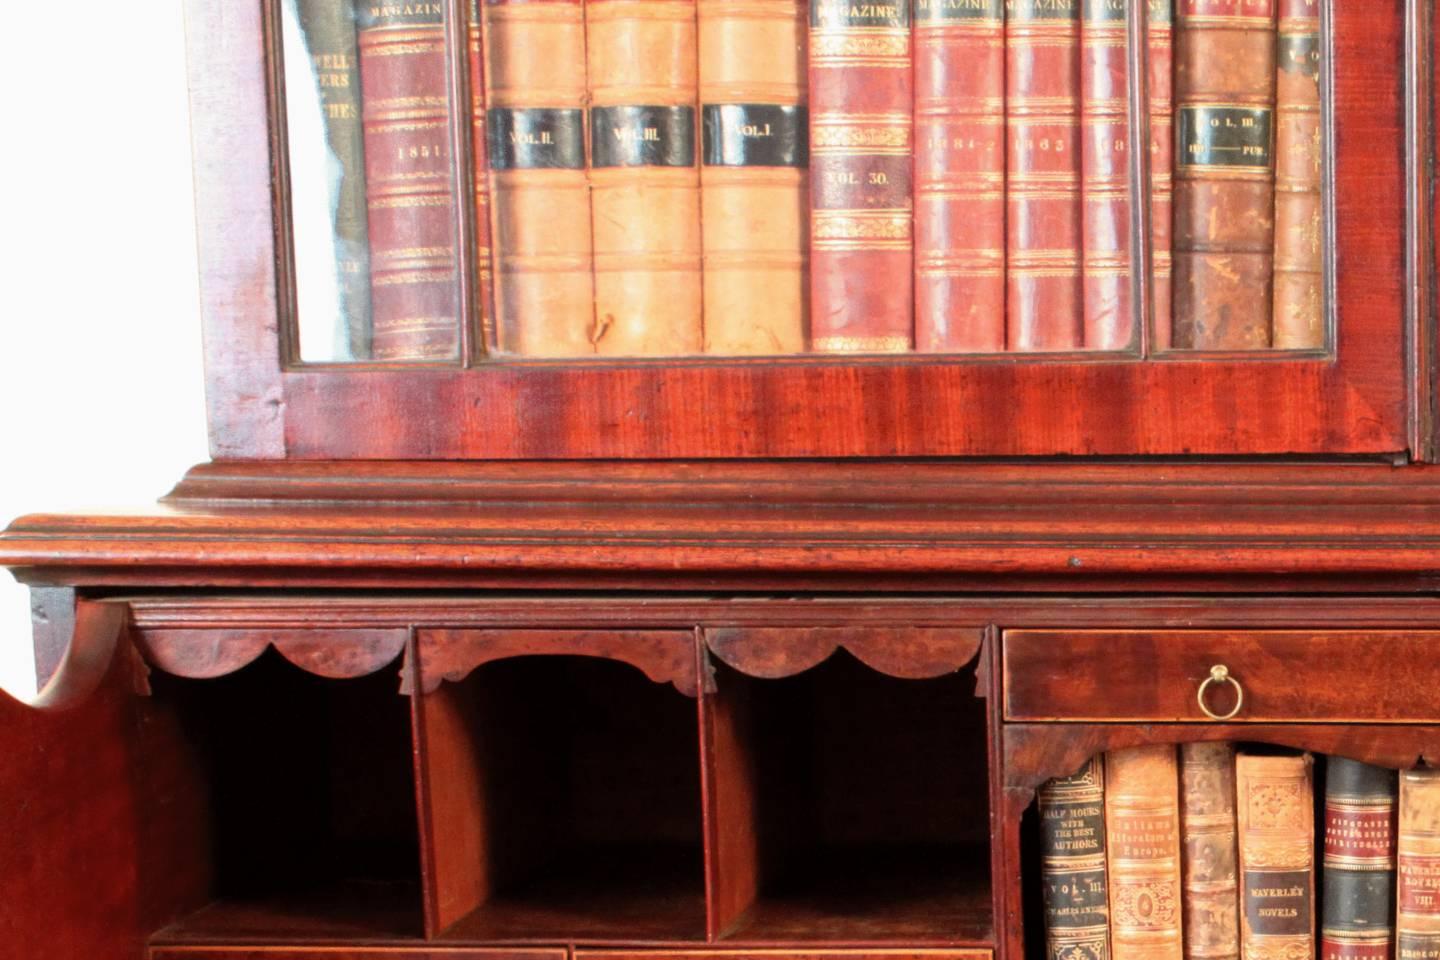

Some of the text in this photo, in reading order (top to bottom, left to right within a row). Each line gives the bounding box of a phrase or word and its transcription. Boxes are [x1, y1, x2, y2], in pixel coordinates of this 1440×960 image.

[371, 4, 441, 17] MAGAZIN
[541, 131, 555, 145] II.
[644, 127, 660, 141] III.
[868, 172, 889, 185] 30.
[1070, 807, 1100, 818] HOURS
[1250, 887, 1304, 897] WAVERLEY
[1258, 908, 1297, 918] NOVELS
